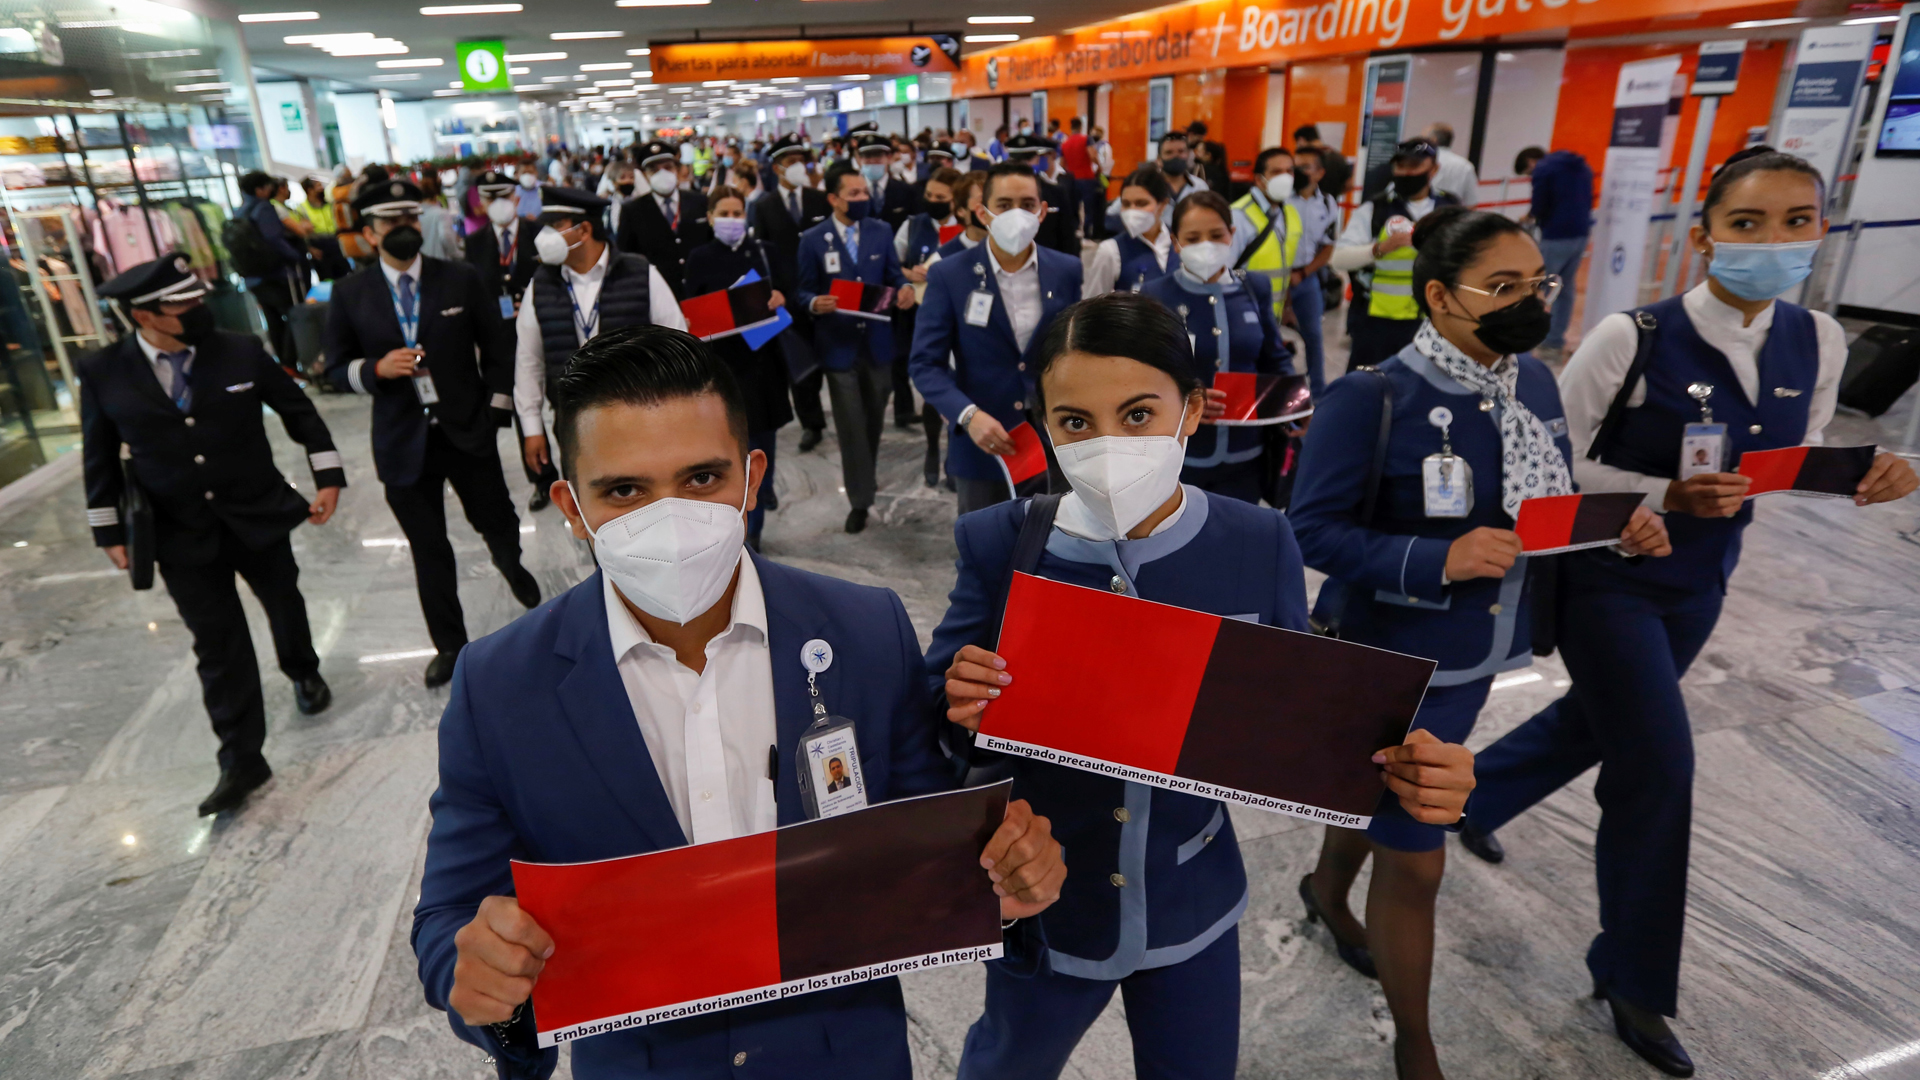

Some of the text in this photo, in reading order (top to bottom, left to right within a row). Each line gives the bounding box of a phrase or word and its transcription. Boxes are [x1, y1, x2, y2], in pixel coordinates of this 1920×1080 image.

[657, 54, 712, 73] Puertas
[716, 56, 749, 74] para
[752, 53, 810, 71] abordar
[819, 51, 871, 69] Boarding
[873, 52, 903, 69] gates
[1009, 53, 1057, 81] Puertas
[1064, 47, 1101, 81] para
[1107, 21, 1194, 69] abordar
[1238, 0, 1410, 52] Boarding
[849, 746, 862, 794] TRIPULACIÓN
[986, 738, 1361, 826] Embargado precautoriamente por los trabajadores de Interjet
[553, 947, 992, 1044] Embargado precautoriamente por los trabajadores de Interjet
